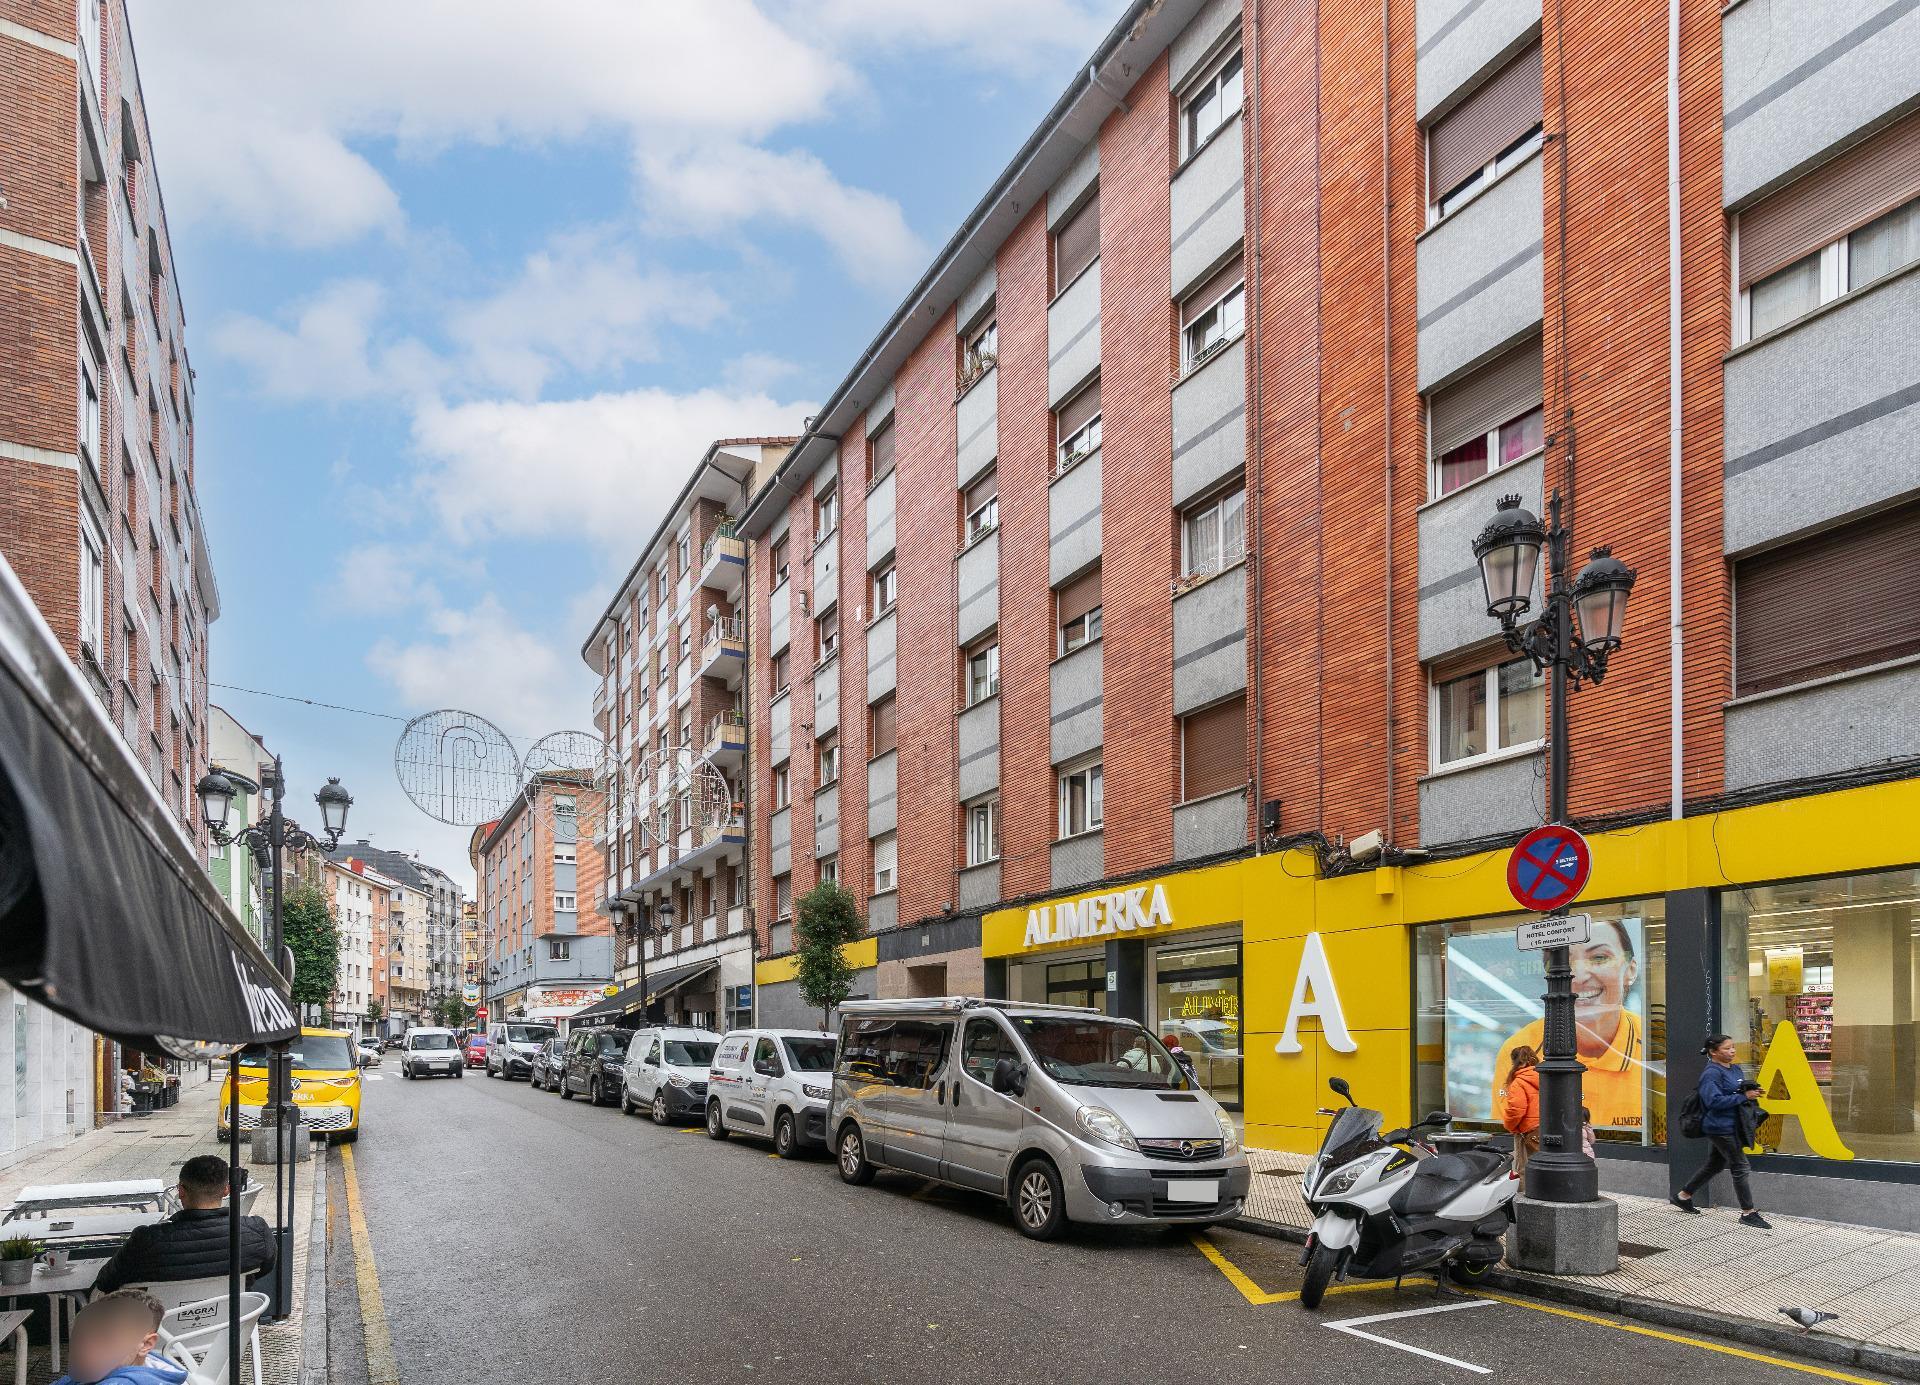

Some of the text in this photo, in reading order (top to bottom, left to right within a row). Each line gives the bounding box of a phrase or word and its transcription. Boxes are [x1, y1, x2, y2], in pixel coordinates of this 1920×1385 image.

[1023, 884, 1173, 947] ALIMERKA
[1531, 920, 1567, 930] RESERVADO
[1546, 927, 1576, 936] CONFORT
[1275, 932, 1358, 1054] A
[1743, 1019, 1855, 1161] A
[1611, 1116, 1643, 1126] ALIMER
[182, 1307, 214, 1316] SAGRA
